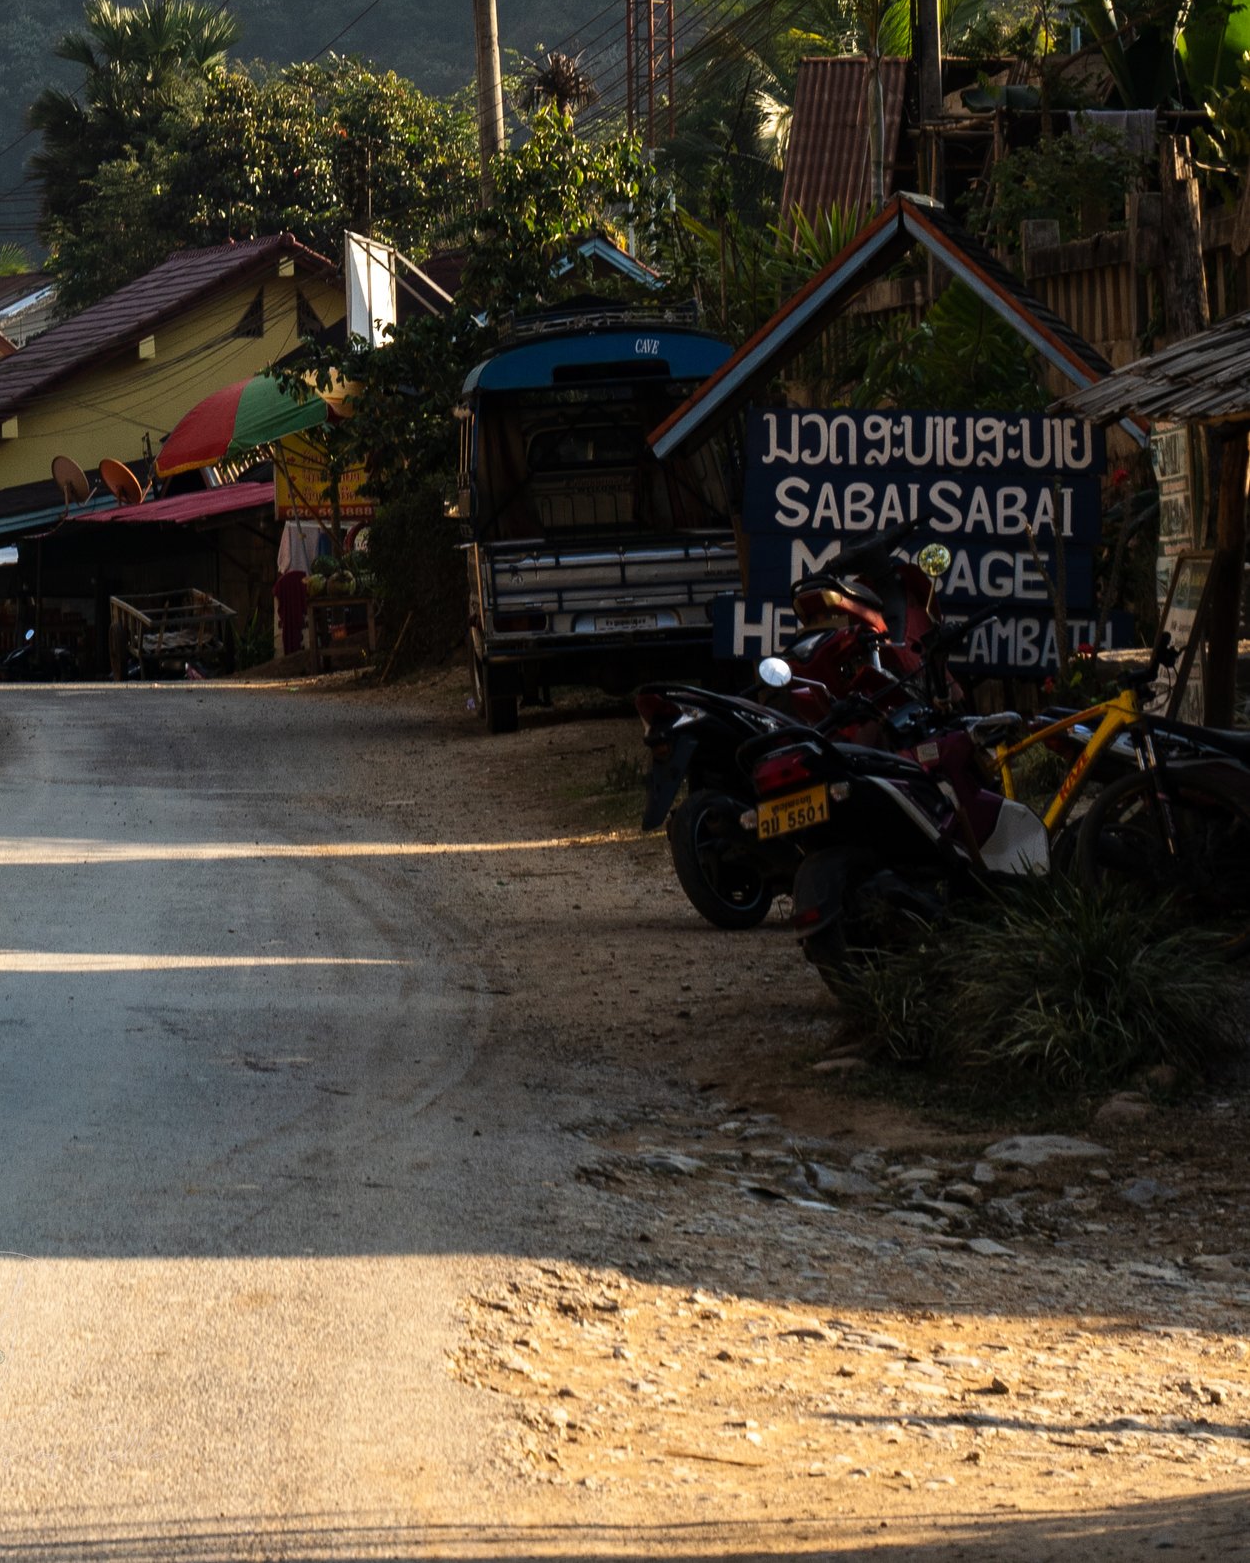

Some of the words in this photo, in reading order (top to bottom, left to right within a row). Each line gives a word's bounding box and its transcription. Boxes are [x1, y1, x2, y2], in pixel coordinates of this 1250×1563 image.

[635, 337, 660, 355] CAVE
[774, 476, 921, 531] SABAI
[929, 480, 1074, 537] SABAI
[790, 539, 1050, 599] MAGE
[787, 803, 825, 828] 5501
